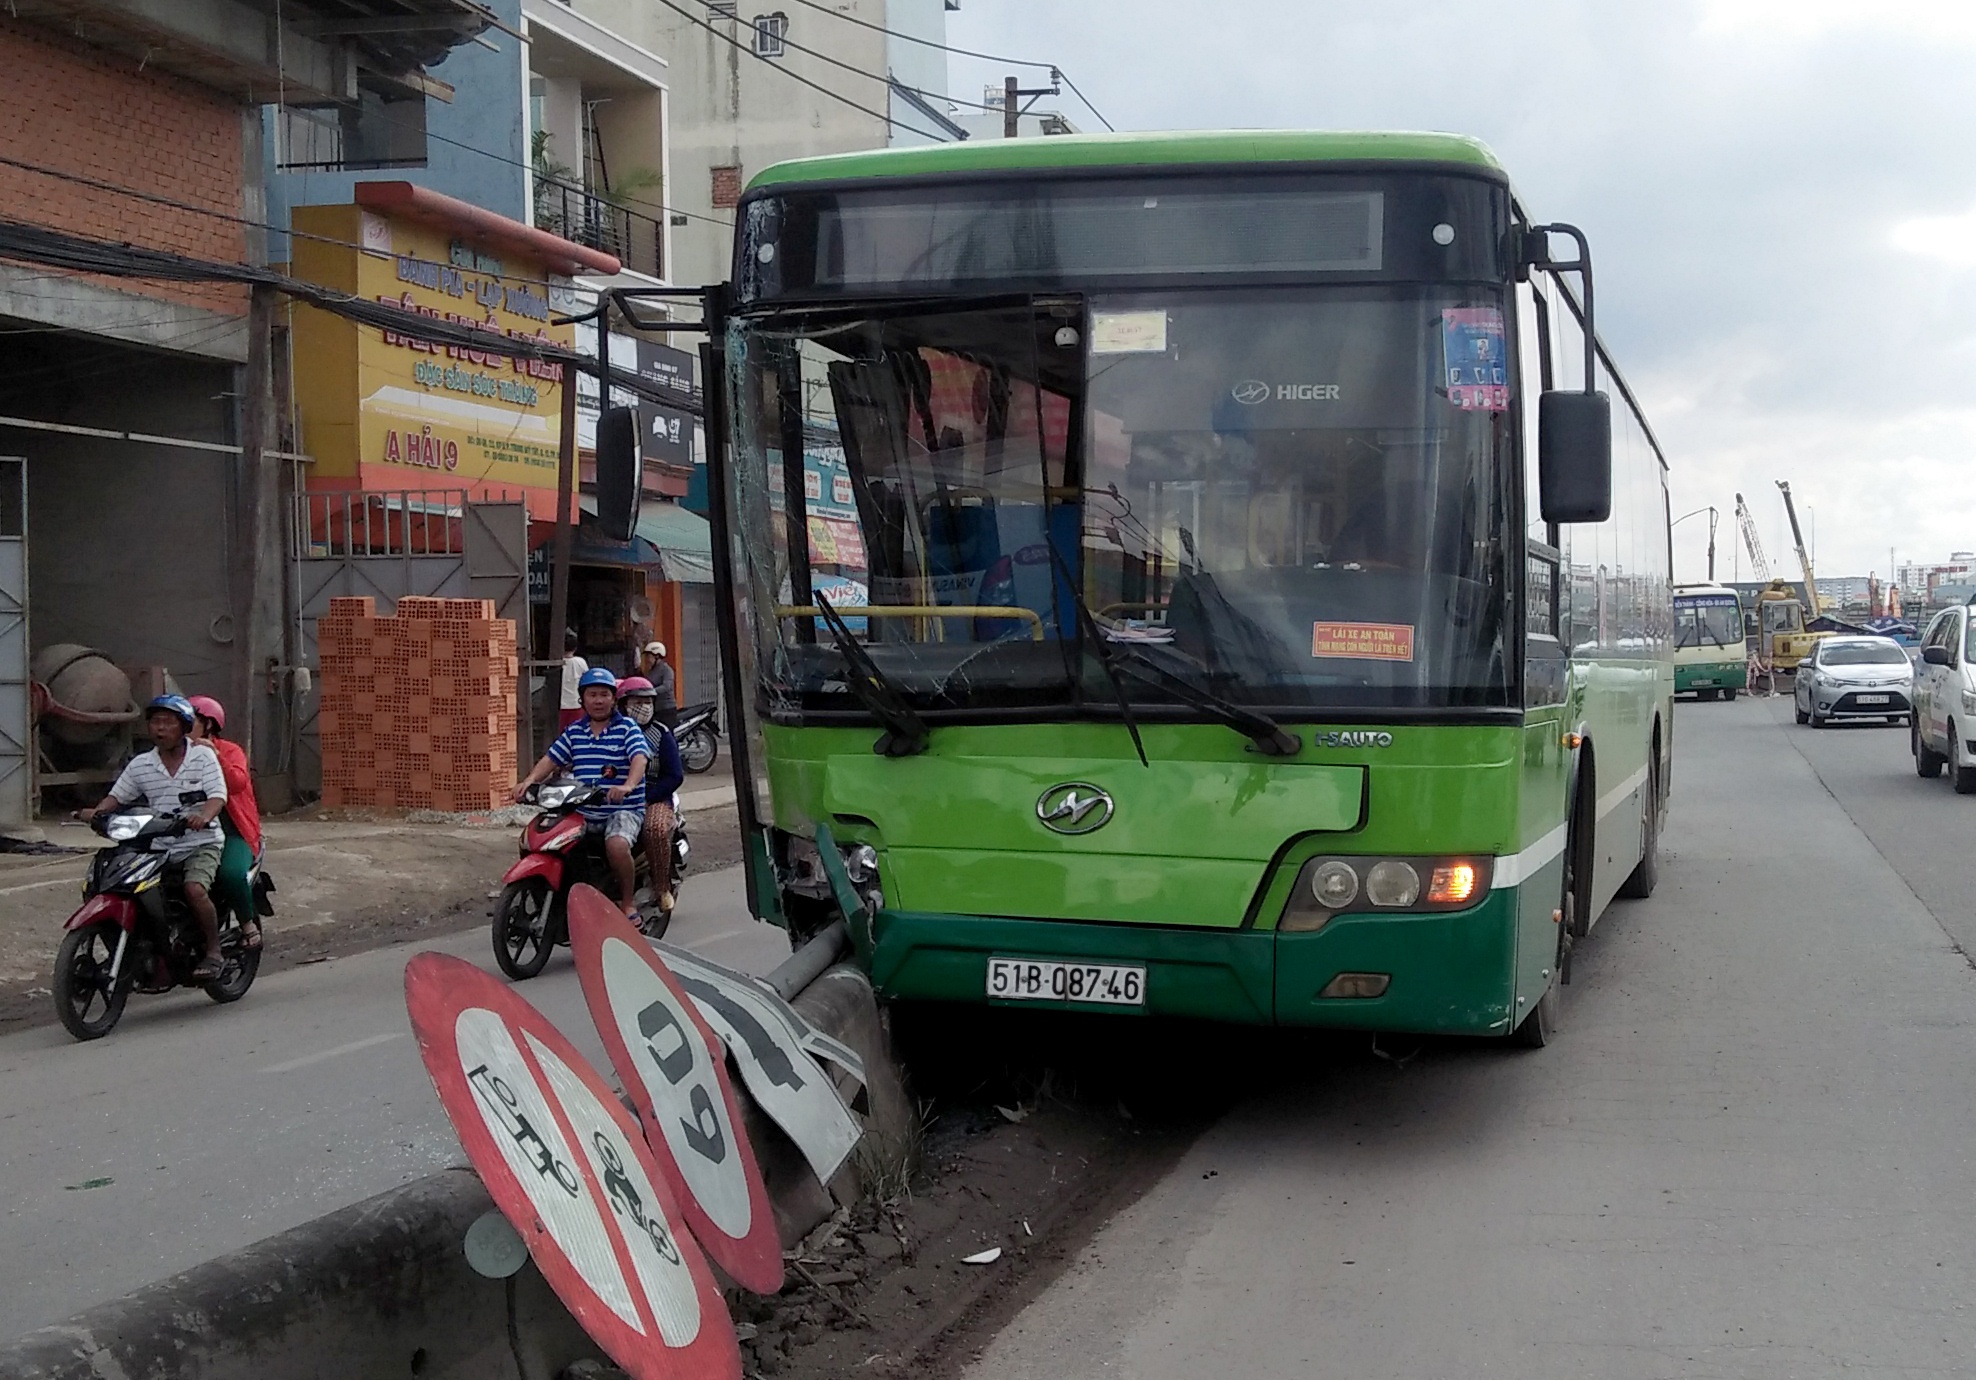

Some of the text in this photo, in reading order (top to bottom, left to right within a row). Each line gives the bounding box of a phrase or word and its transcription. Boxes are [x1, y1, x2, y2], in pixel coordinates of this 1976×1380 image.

[415, 360, 443, 391] ĐẶC
[445, 363, 471, 392] SẢN
[474, 371, 497, 397] SÓC
[1277, 383, 1340, 400] HIGER
[386, 429, 401, 462] A
[406, 424, 443, 469] HẢI
[444, 439, 460, 471] 9
[1332, 627, 1346, 639] LÁI
[1348, 630, 1358, 640] XE
[1360, 630, 1372, 640] AN
[1373, 629, 1395, 641] TOÀN
